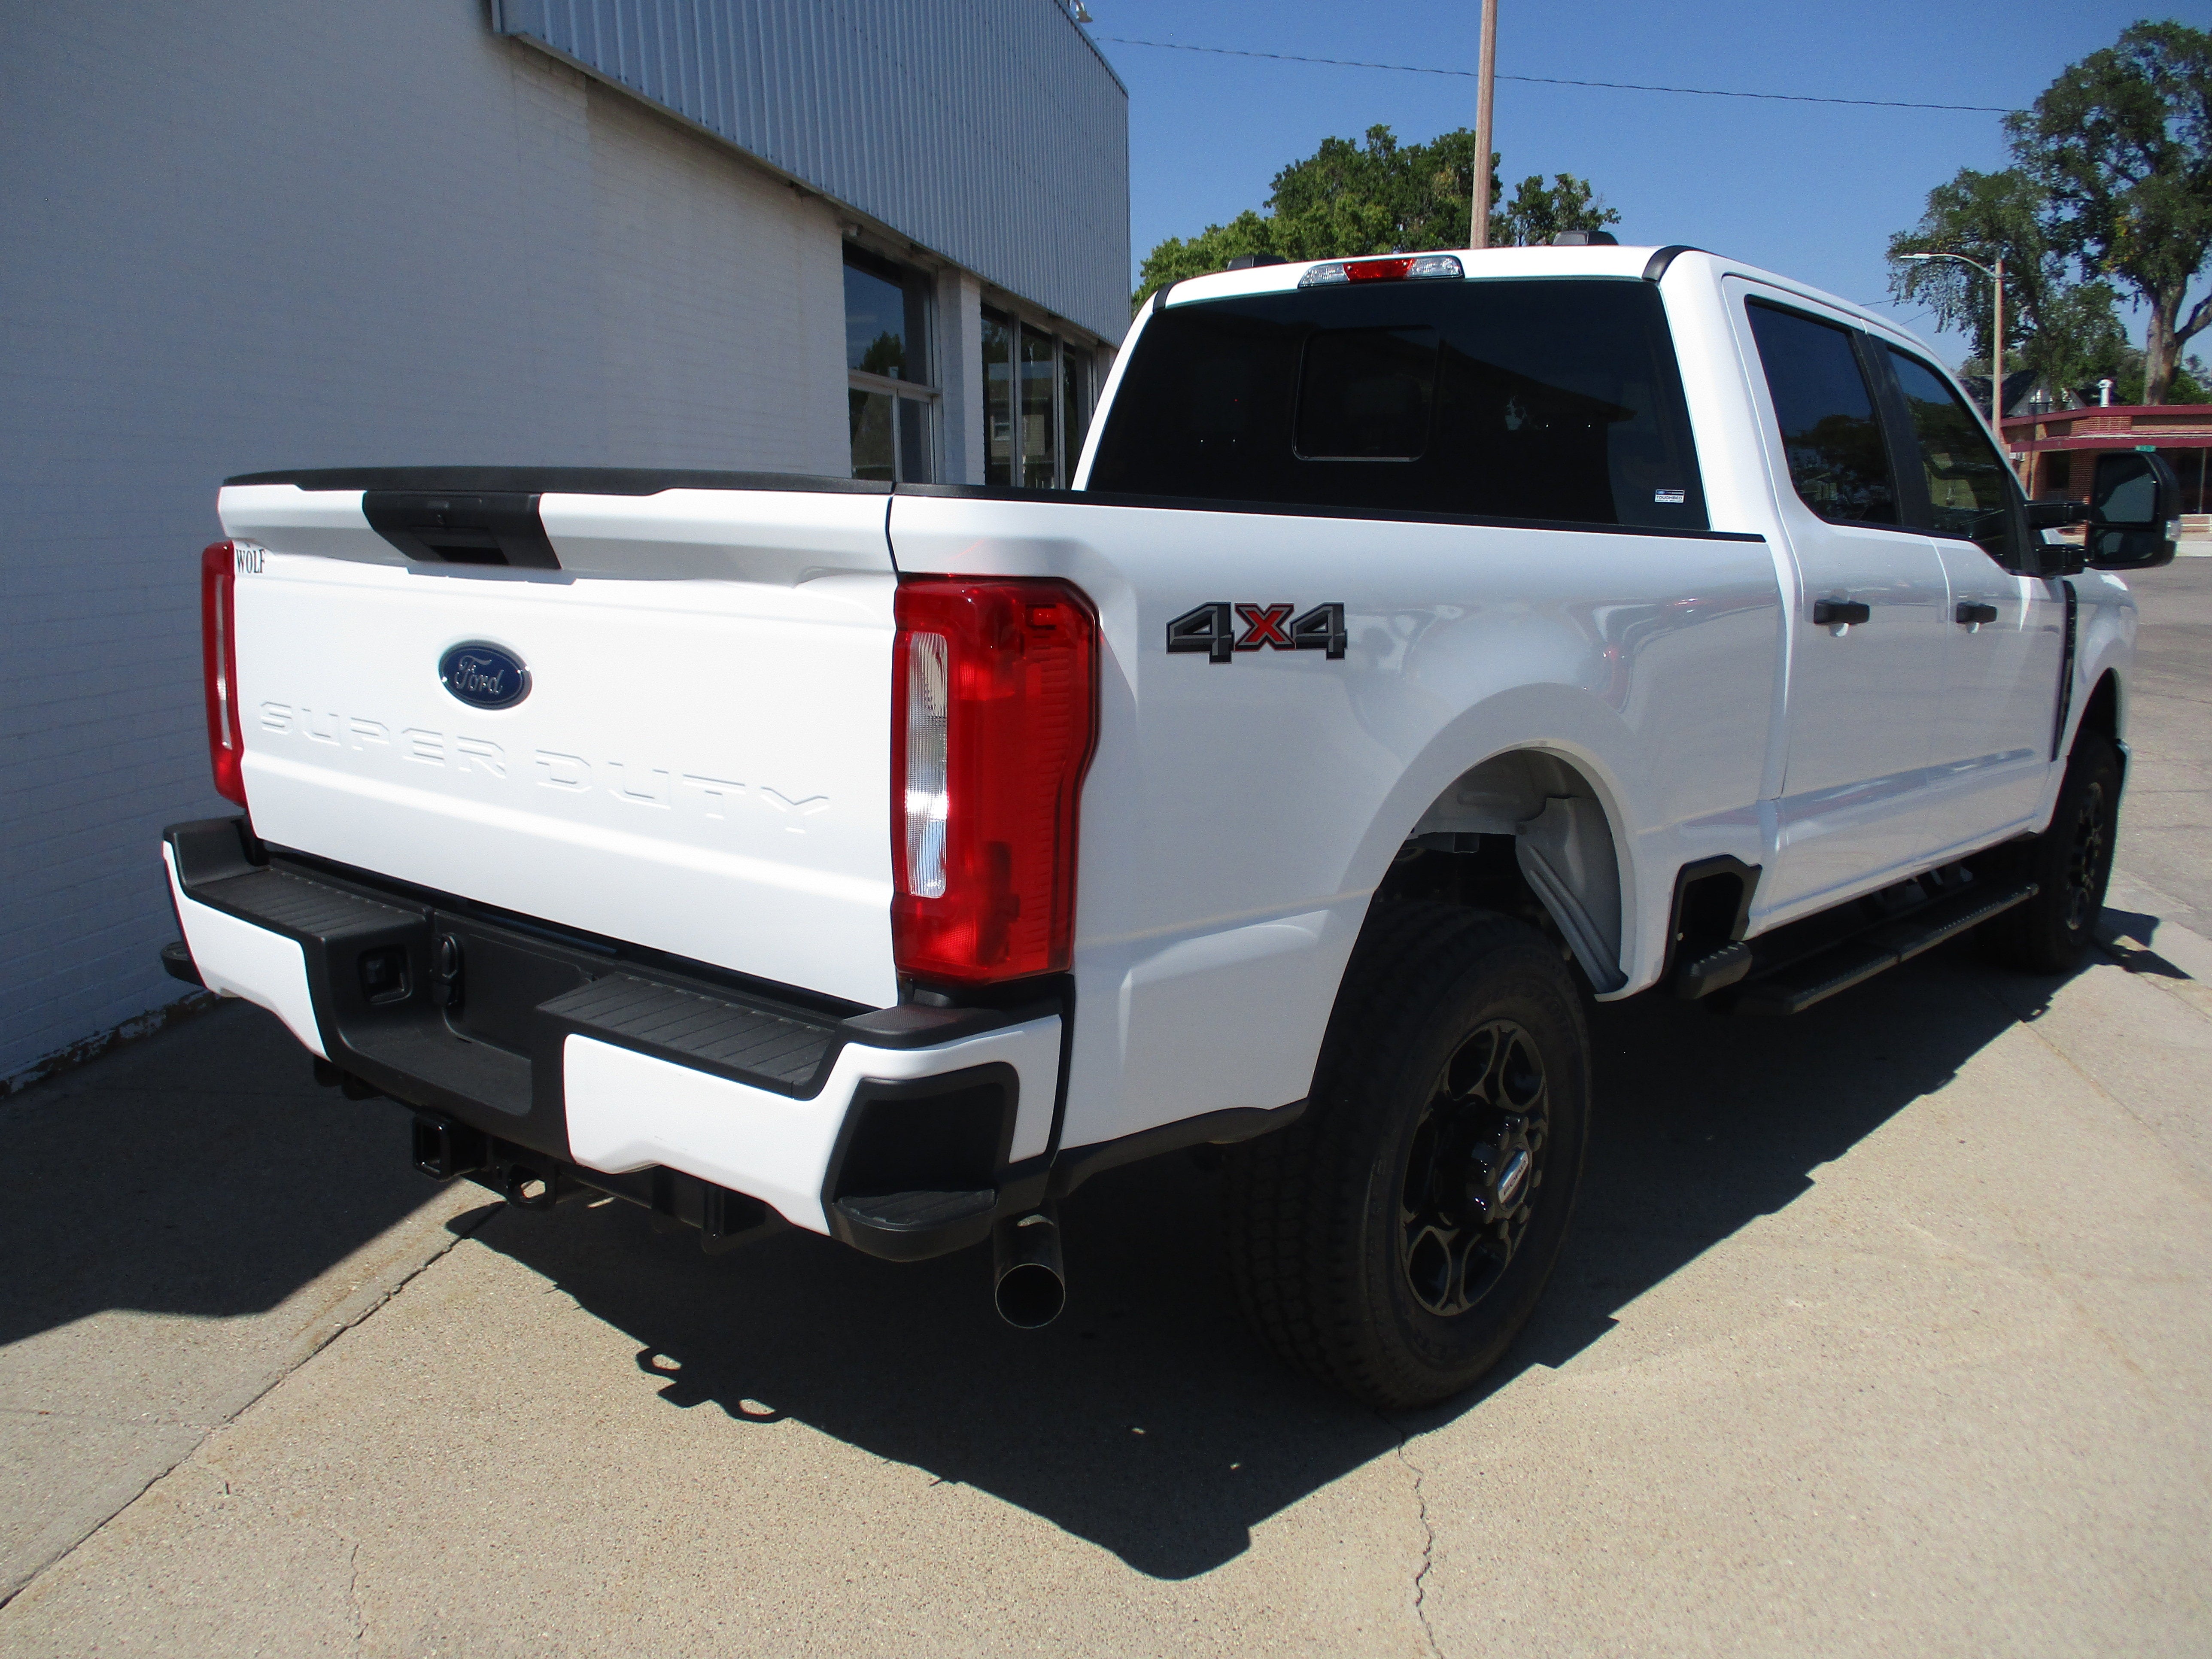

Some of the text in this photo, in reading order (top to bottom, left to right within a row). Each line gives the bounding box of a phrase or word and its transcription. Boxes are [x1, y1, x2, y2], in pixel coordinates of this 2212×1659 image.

[236, 548, 266, 574] WOLF
[454, 654, 504, 696] Ford
[261, 702, 830, 833] SUPER DUTY
